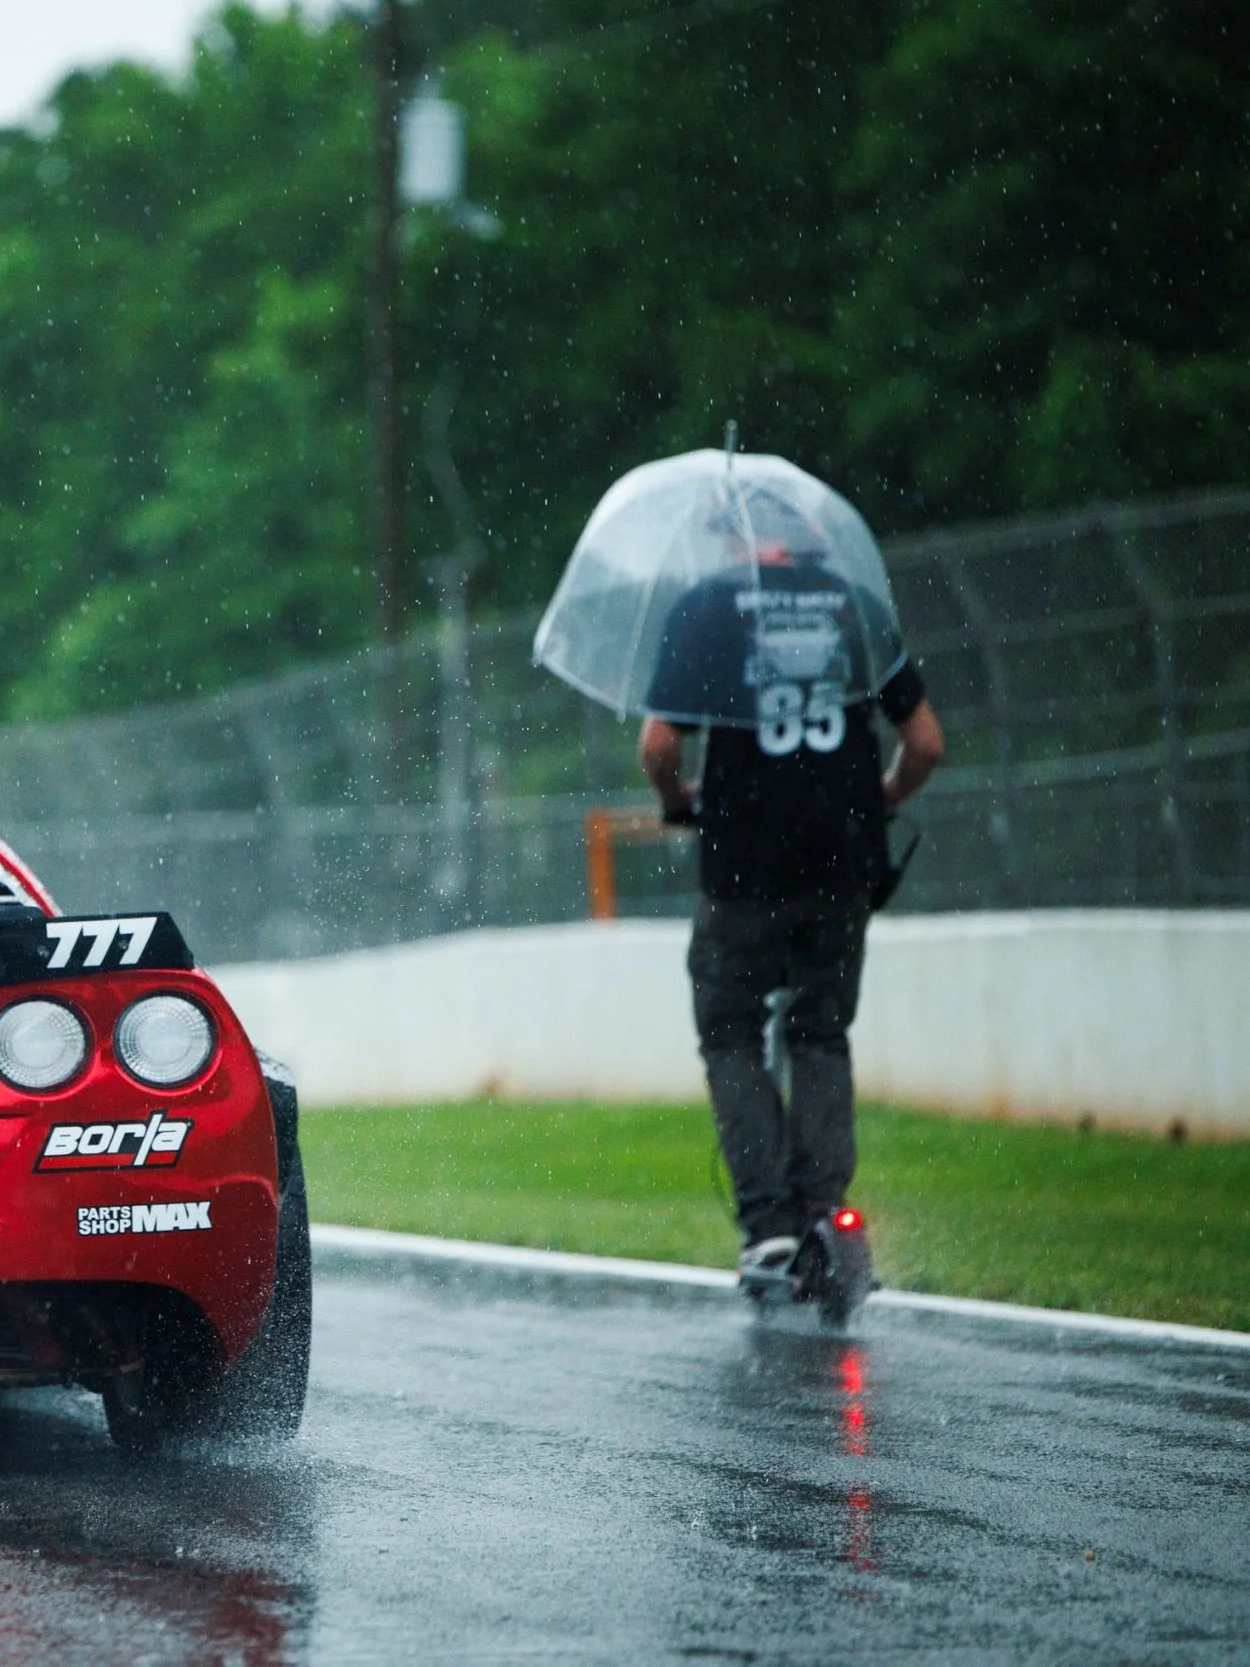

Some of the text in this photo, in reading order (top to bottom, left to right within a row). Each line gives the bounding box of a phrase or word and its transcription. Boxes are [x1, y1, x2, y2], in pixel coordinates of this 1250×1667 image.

[758, 682, 846, 757] 85
[46, 917, 158, 969] 777
[78, 1206, 131, 1221] PARTS
[78, 1201, 212, 1235] SHOP MAX
